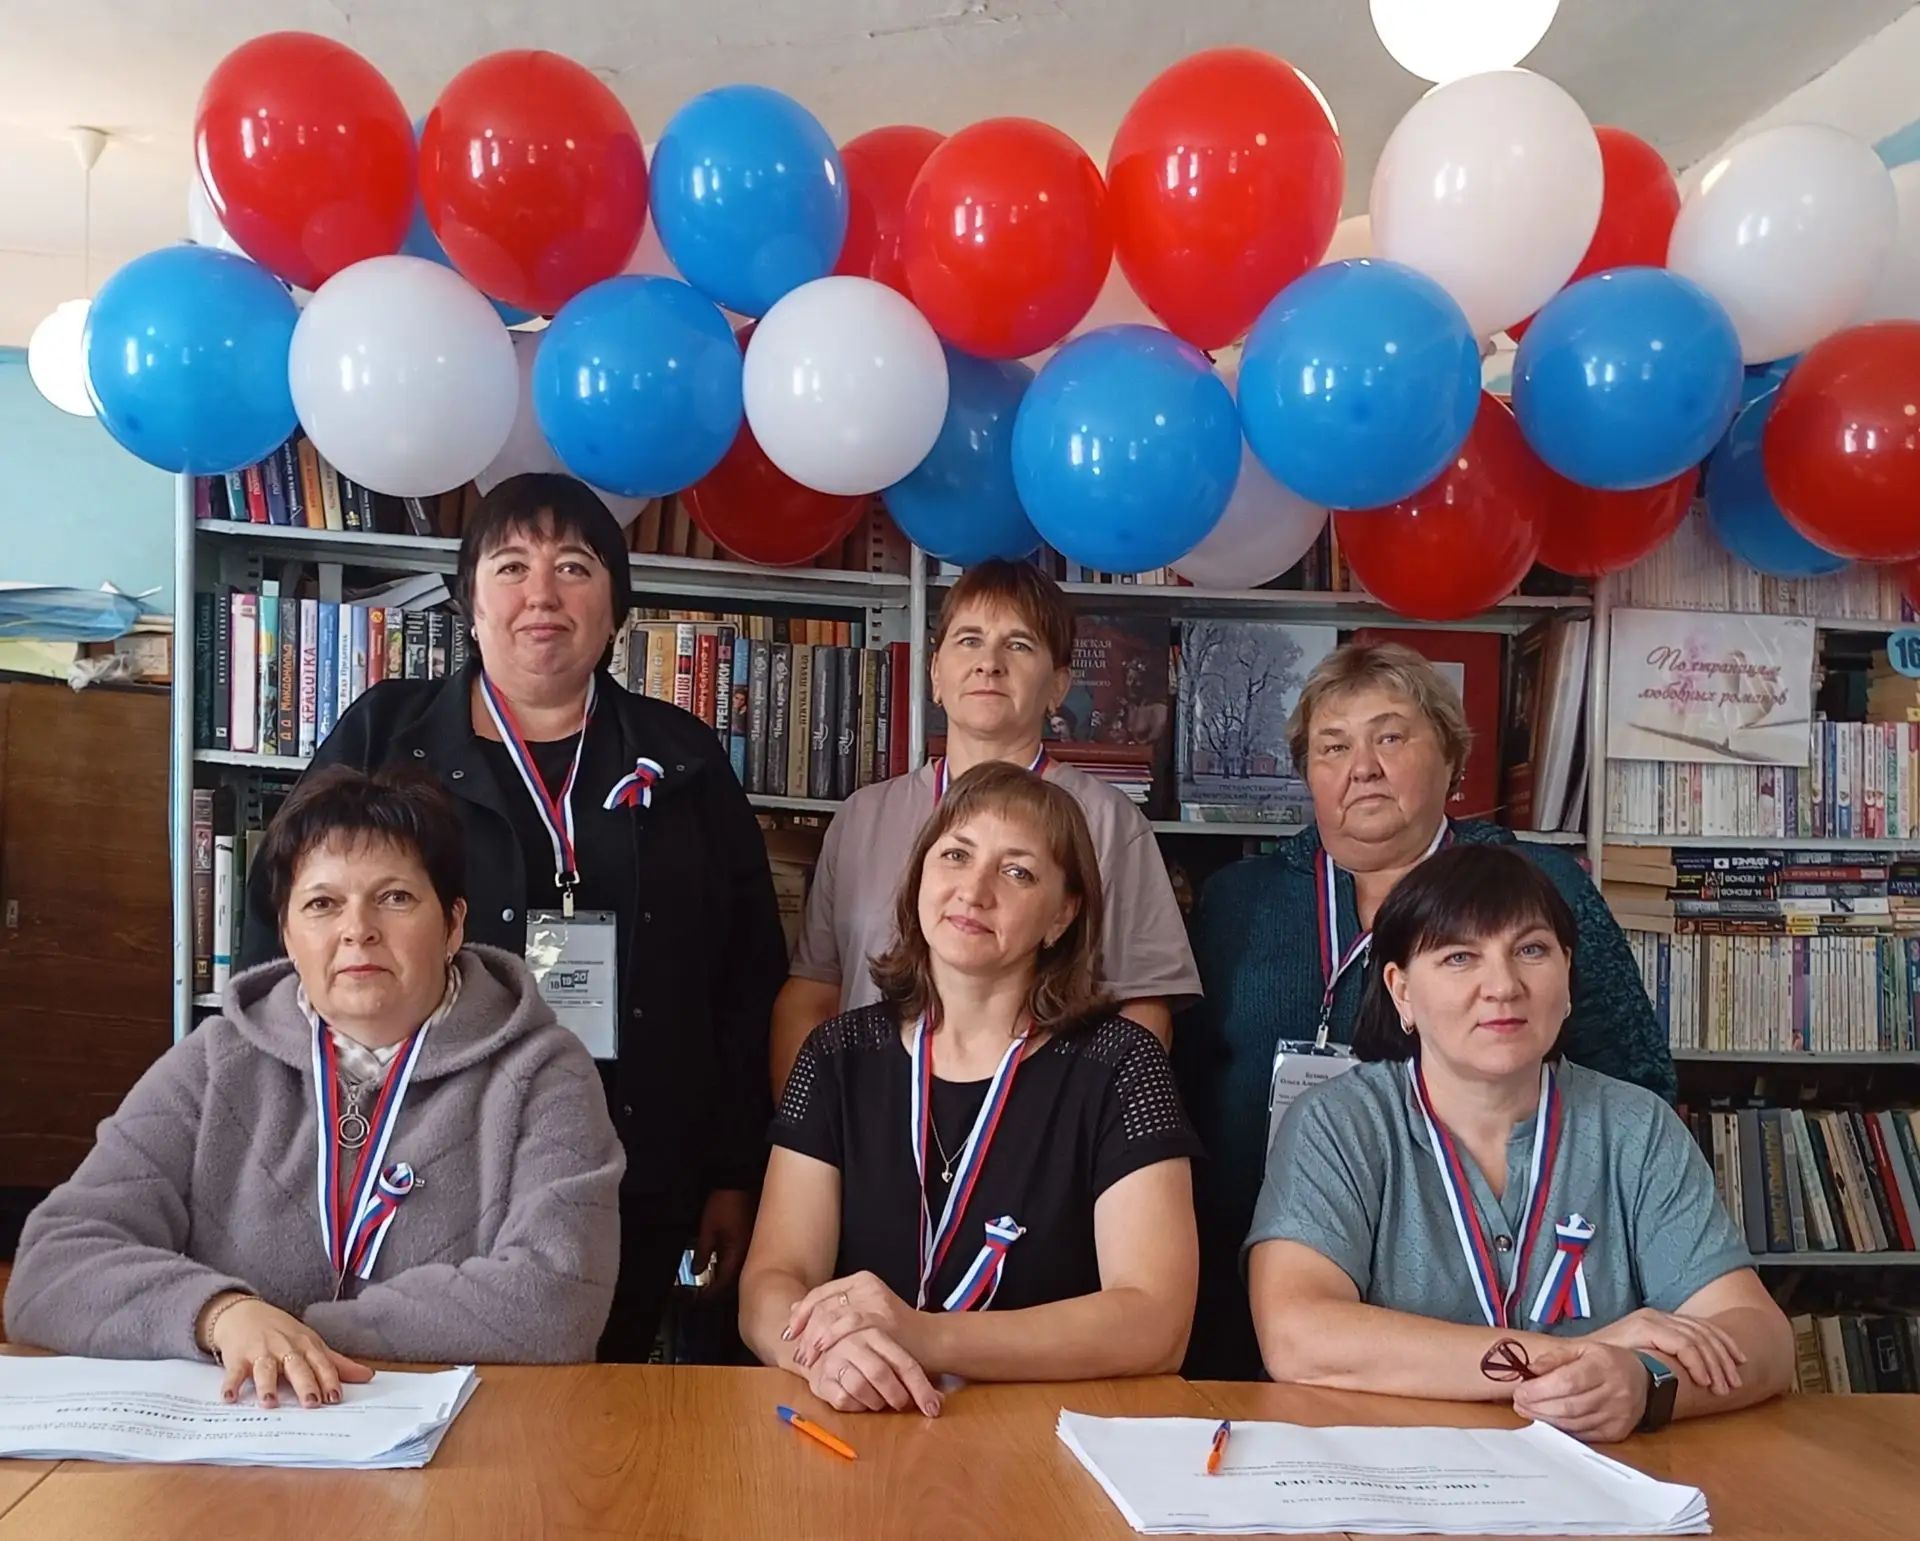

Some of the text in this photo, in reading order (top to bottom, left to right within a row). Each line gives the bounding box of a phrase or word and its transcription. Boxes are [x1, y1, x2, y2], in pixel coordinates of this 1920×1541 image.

[1646, 646, 1687, 672] По
[302, 647, 317, 724] КРАСОТКА
[716, 663, 731, 730] ГРЕШНИКИ
[1638, 678, 1718, 703] любовных
[1724, 875, 1757, 883] ЛЕОНОВ
[1721, 888, 1753, 897] ЛЕОНОВ
